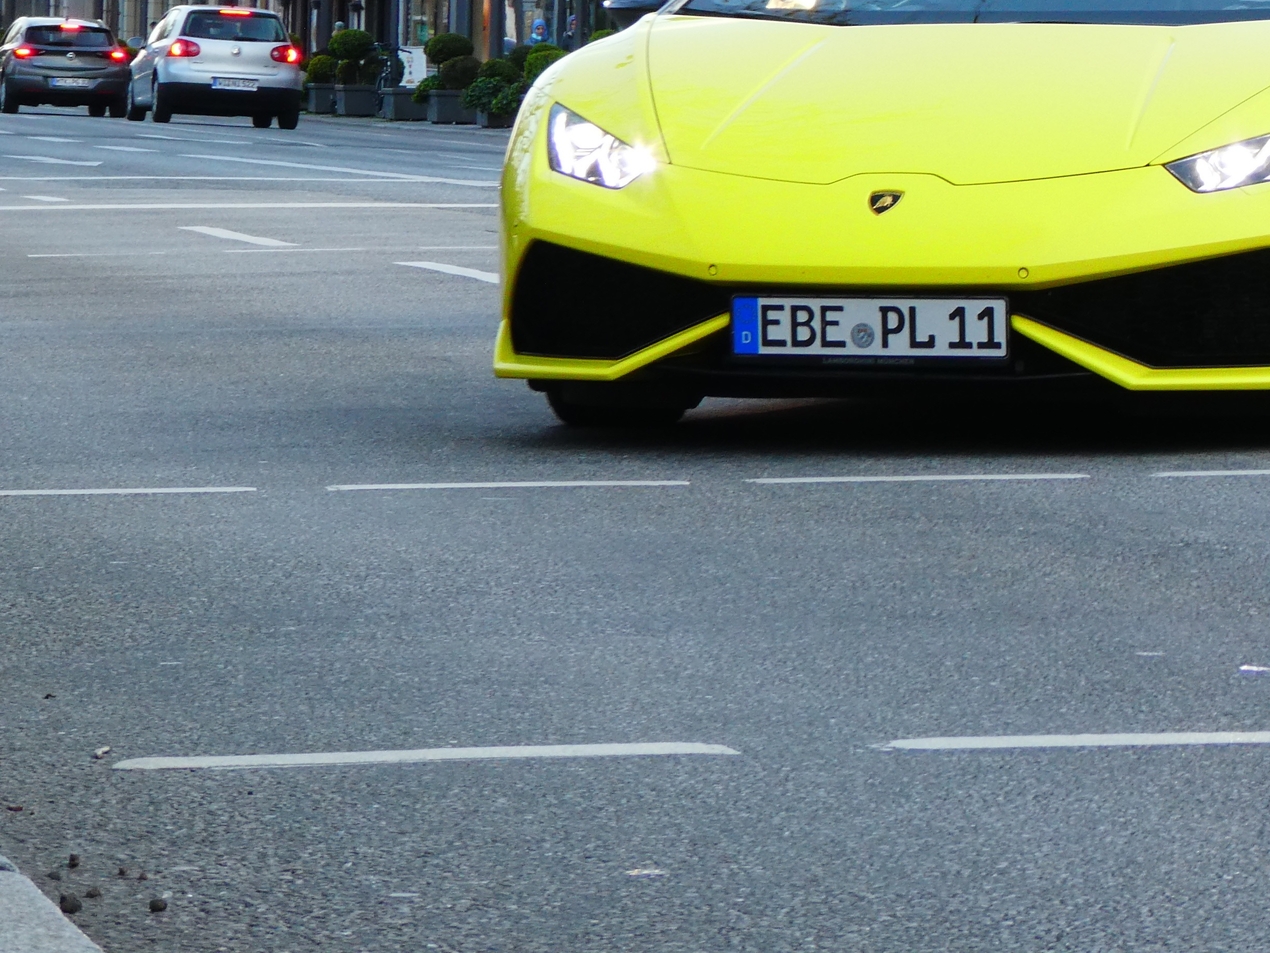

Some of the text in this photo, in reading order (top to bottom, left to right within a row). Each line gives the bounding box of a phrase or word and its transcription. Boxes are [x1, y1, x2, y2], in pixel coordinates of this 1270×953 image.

[742, 304, 1002, 350] D EBE PL 11
